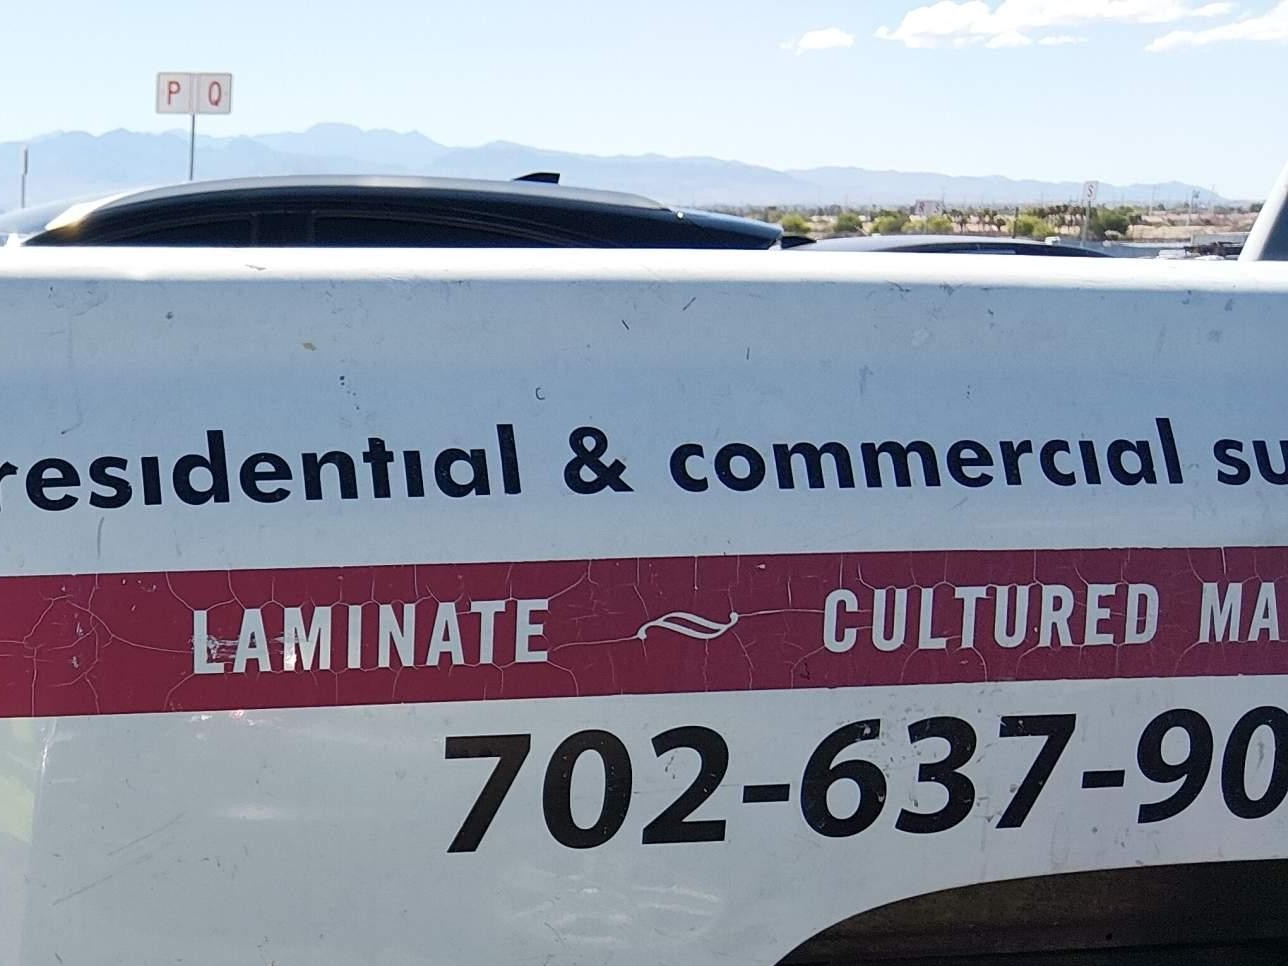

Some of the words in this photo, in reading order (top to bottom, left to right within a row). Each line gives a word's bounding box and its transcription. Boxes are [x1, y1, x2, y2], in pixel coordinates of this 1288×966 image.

[168, 81, 181, 105] P
[208, 81, 221, 106] Q
[564, 426, 634, 494] &
[669, 417, 1184, 493] commercial
[1213, 439, 1288, 485] su
[193, 599, 549, 675] LAMINATE
[822, 582, 1159, 653] CULTURED
[1199, 582, 1280, 643] MA
[444, 705, 1288, 853] 702-637-90
